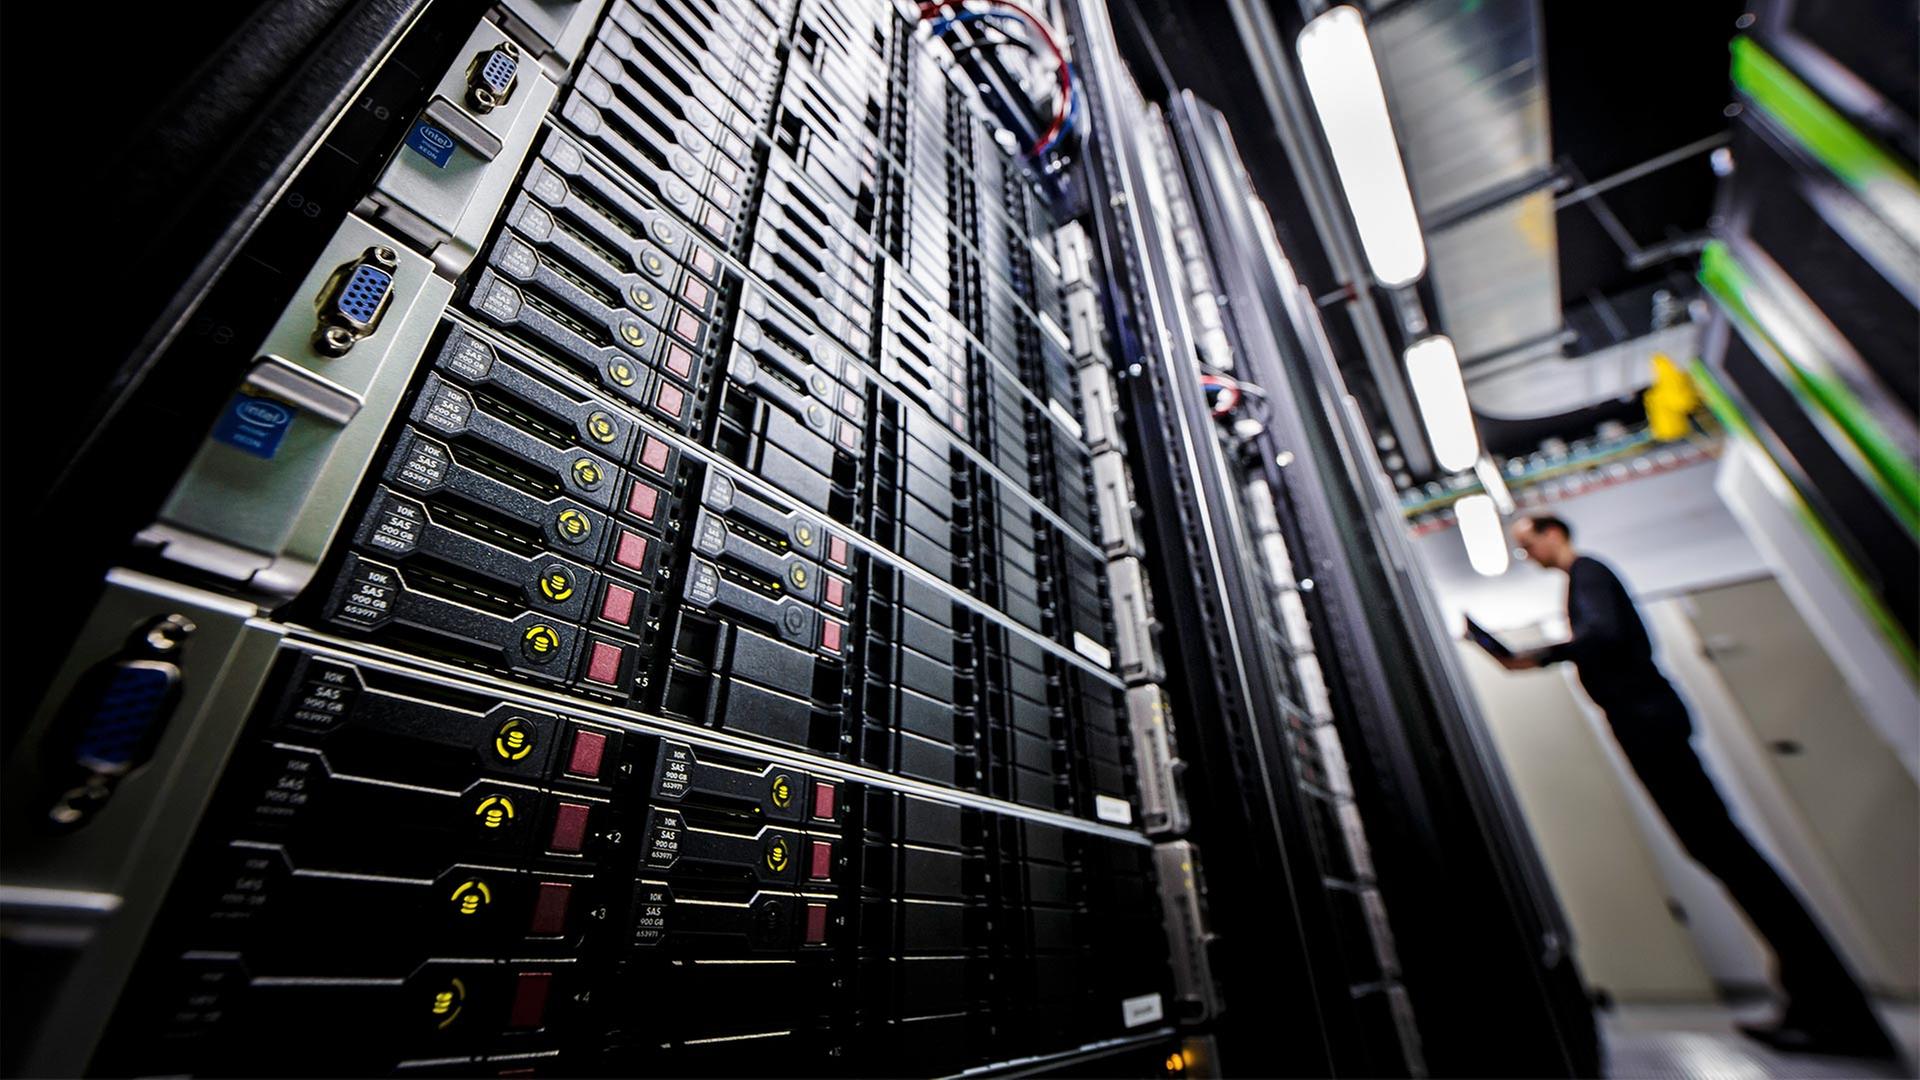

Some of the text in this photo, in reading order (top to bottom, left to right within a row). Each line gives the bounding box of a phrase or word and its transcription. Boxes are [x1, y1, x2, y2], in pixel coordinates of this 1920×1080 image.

[361, 96, 389, 121] 10
[424, 127, 449, 147] intel
[287, 192, 321, 218] 09
[471, 341, 485, 351] 10K
[459, 353, 485, 371] 900 GB
[466, 350, 482, 362] SAS
[447, 391, 463, 402] 10K
[441, 399, 460, 413] SAS
[434, 405, 462, 422] 900 GB
[424, 445, 441, 457] 10K
[417, 455, 438, 469] SAS
[409, 461, 440, 478] 900 GB
[402, 470, 432, 485] 653971
[397, 505, 415, 518] 10K
[389, 517, 412, 530] SAS
[381, 524, 414, 541] 900 GB
[373, 534, 405, 548] 653971
[368, 571, 389, 584] 10K
[664, 569, 670, 580] 3
[360, 585, 384, 598] SAS
[351, 593, 388, 609] 900 GB
[344, 604, 378, 618] 653971
[323, 671, 346, 684] 10K
[641, 676, 649, 688] 5
[314, 686, 341, 700] SAS
[303, 696, 345, 712] 900 GB
[673, 750, 686, 760] 10K
[671, 762, 685, 773] SAS
[665, 771, 688, 781] 900 GB
[662, 781, 684, 790] 653971
[664, 817, 677, 827] 10K
[613, 832, 622, 844] 2
[661, 830, 675, 840] SAS
[655, 839, 678, 850] 900 GB
[651, 851, 673, 860] 653971
[649, 892, 663, 902] 10K
[598, 907, 606, 920] 3
[646, 906, 661, 917] SAS
[640, 917, 665, 927] 900 GB
[636, 930, 660, 939] 653971
